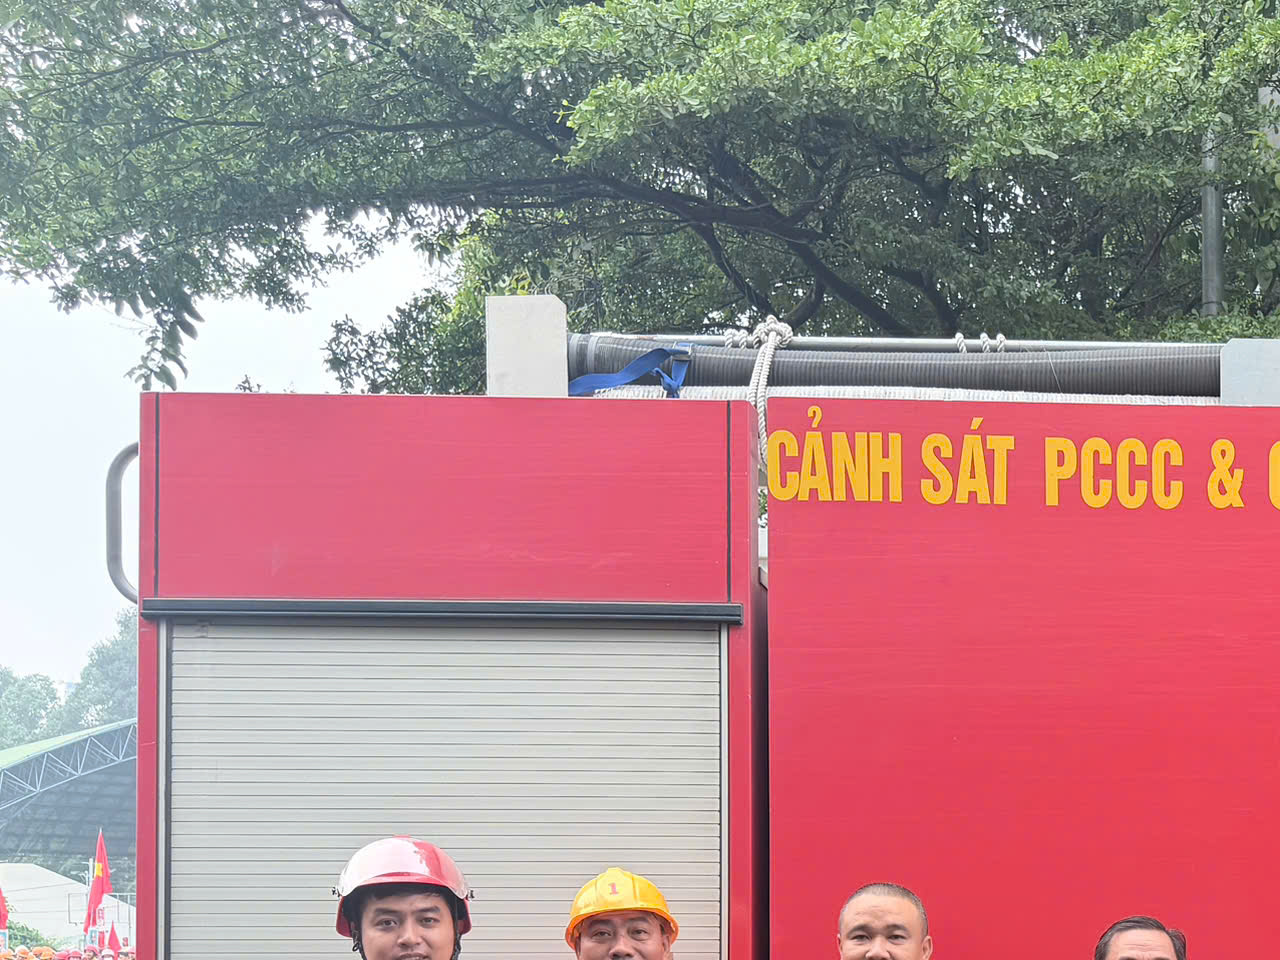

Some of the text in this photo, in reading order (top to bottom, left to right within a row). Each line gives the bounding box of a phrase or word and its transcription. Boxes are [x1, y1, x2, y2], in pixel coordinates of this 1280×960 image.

[767, 406, 902, 503] CẢNH
[921, 417, 1015, 505] SÁT
[1045, 437, 1184, 510] PCCC
[1207, 439, 1245, 510] &
